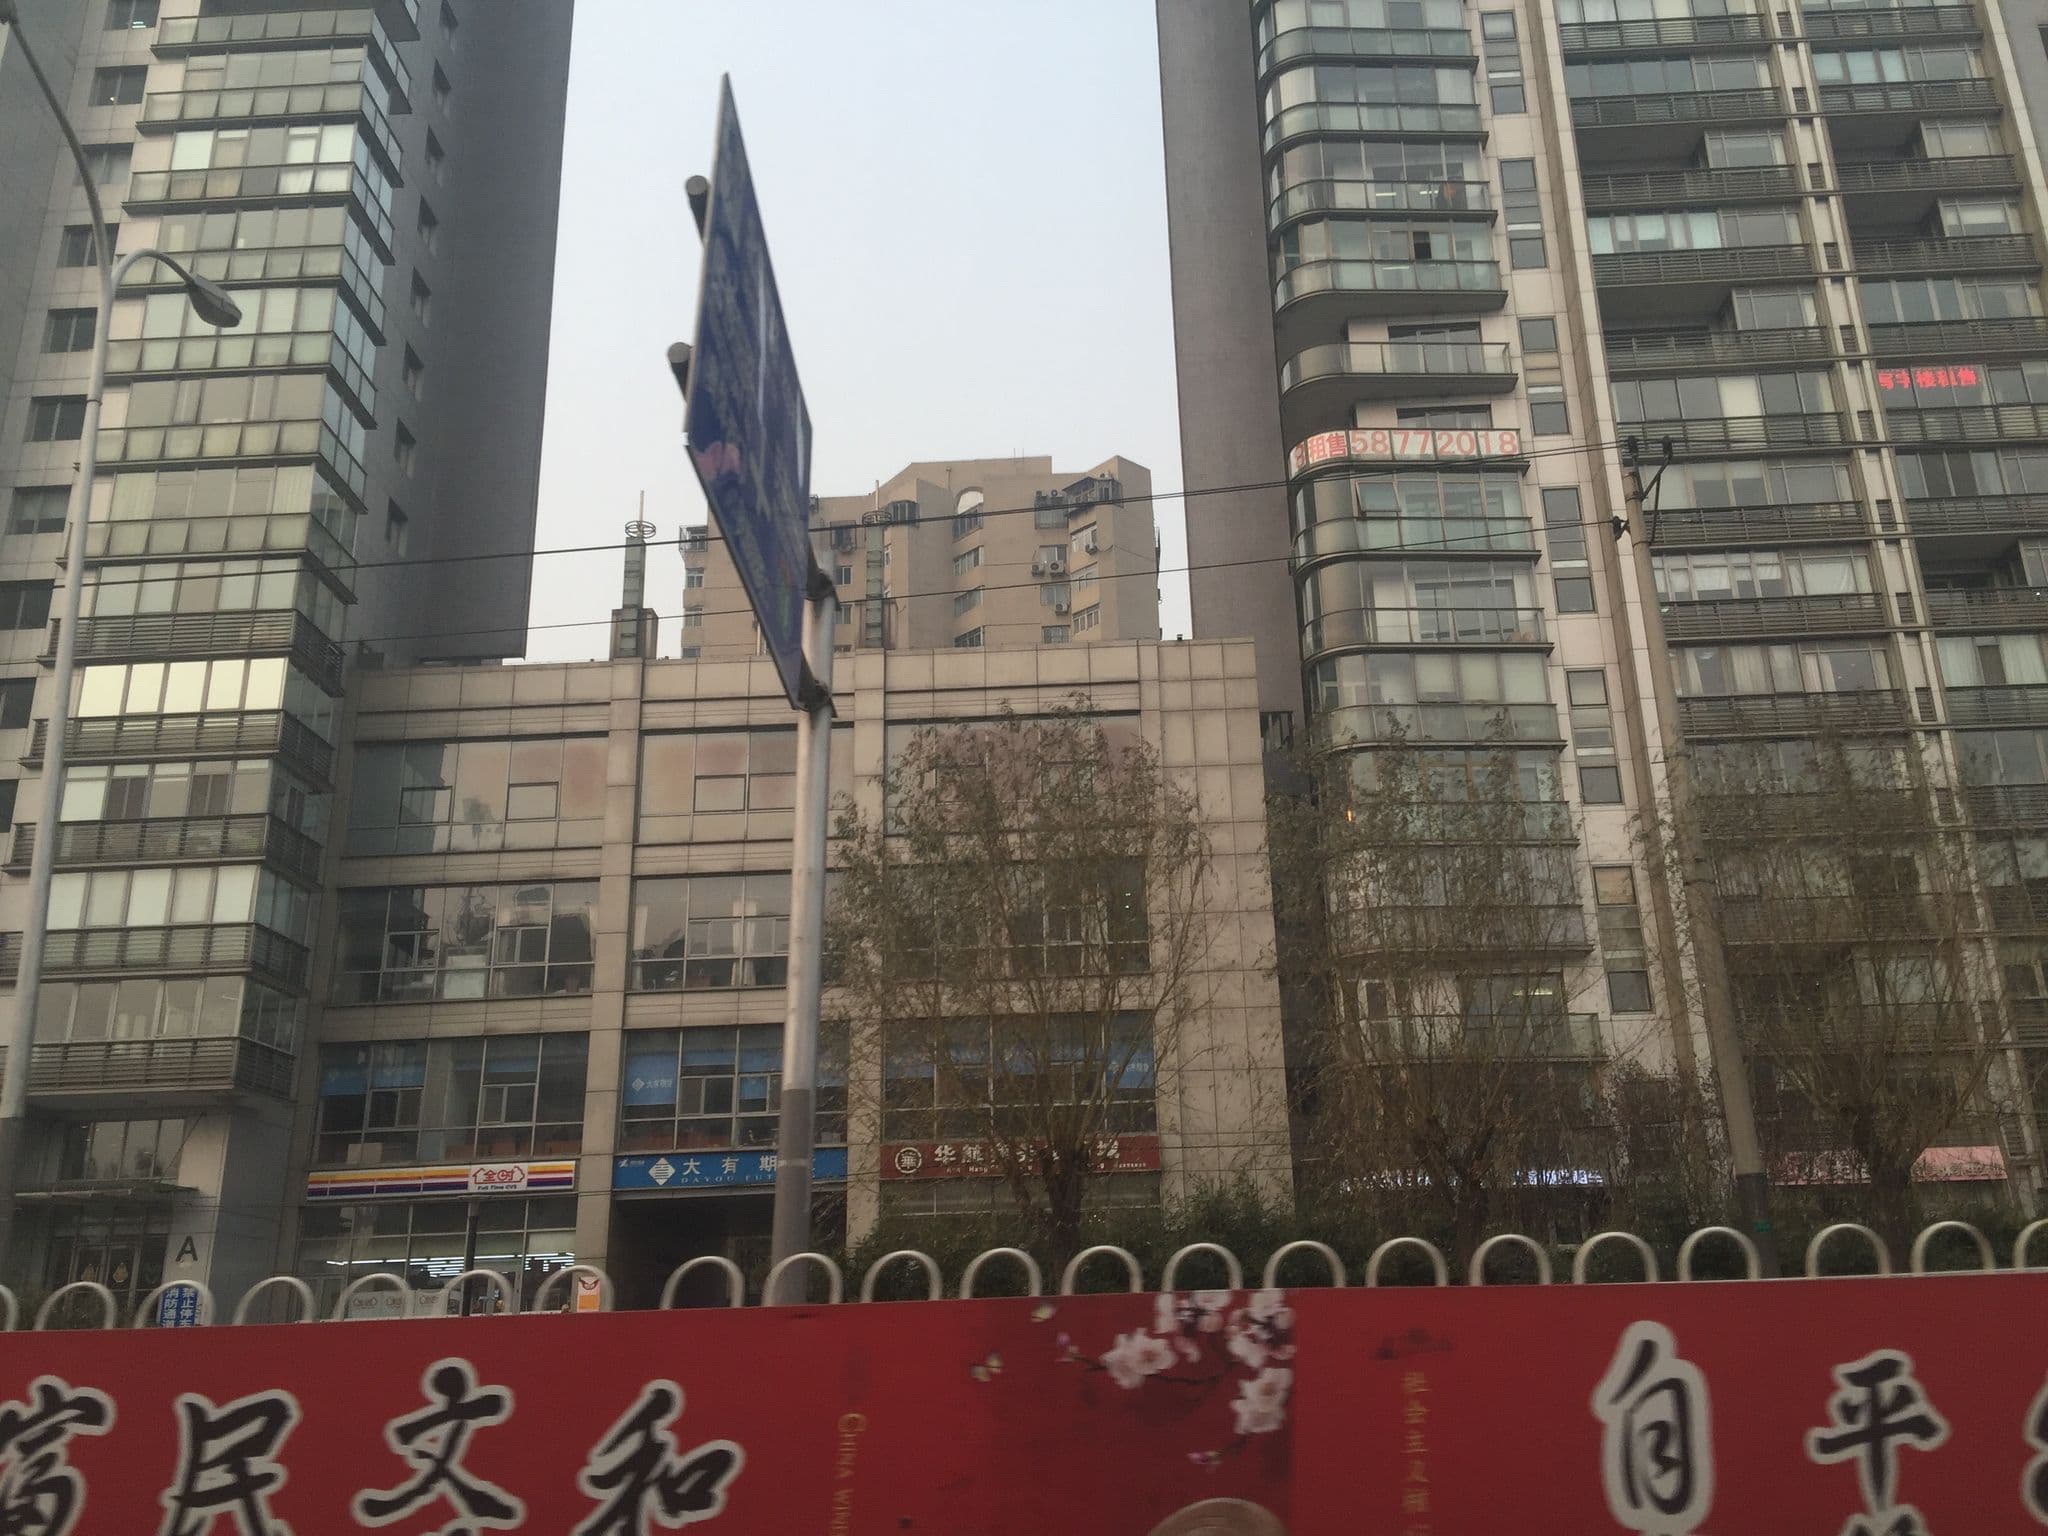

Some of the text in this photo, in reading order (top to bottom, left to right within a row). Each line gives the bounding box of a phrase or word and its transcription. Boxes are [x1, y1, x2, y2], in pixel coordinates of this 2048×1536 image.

[1350, 430, 1518, 456] 58772018
[682, 1154, 814, 1178] 大有期
[175, 1235, 198, 1262] A
[355, 1358, 522, 1529] 文
[575, 1381, 742, 1536] 和
[1808, 1351, 1948, 1518] 平
